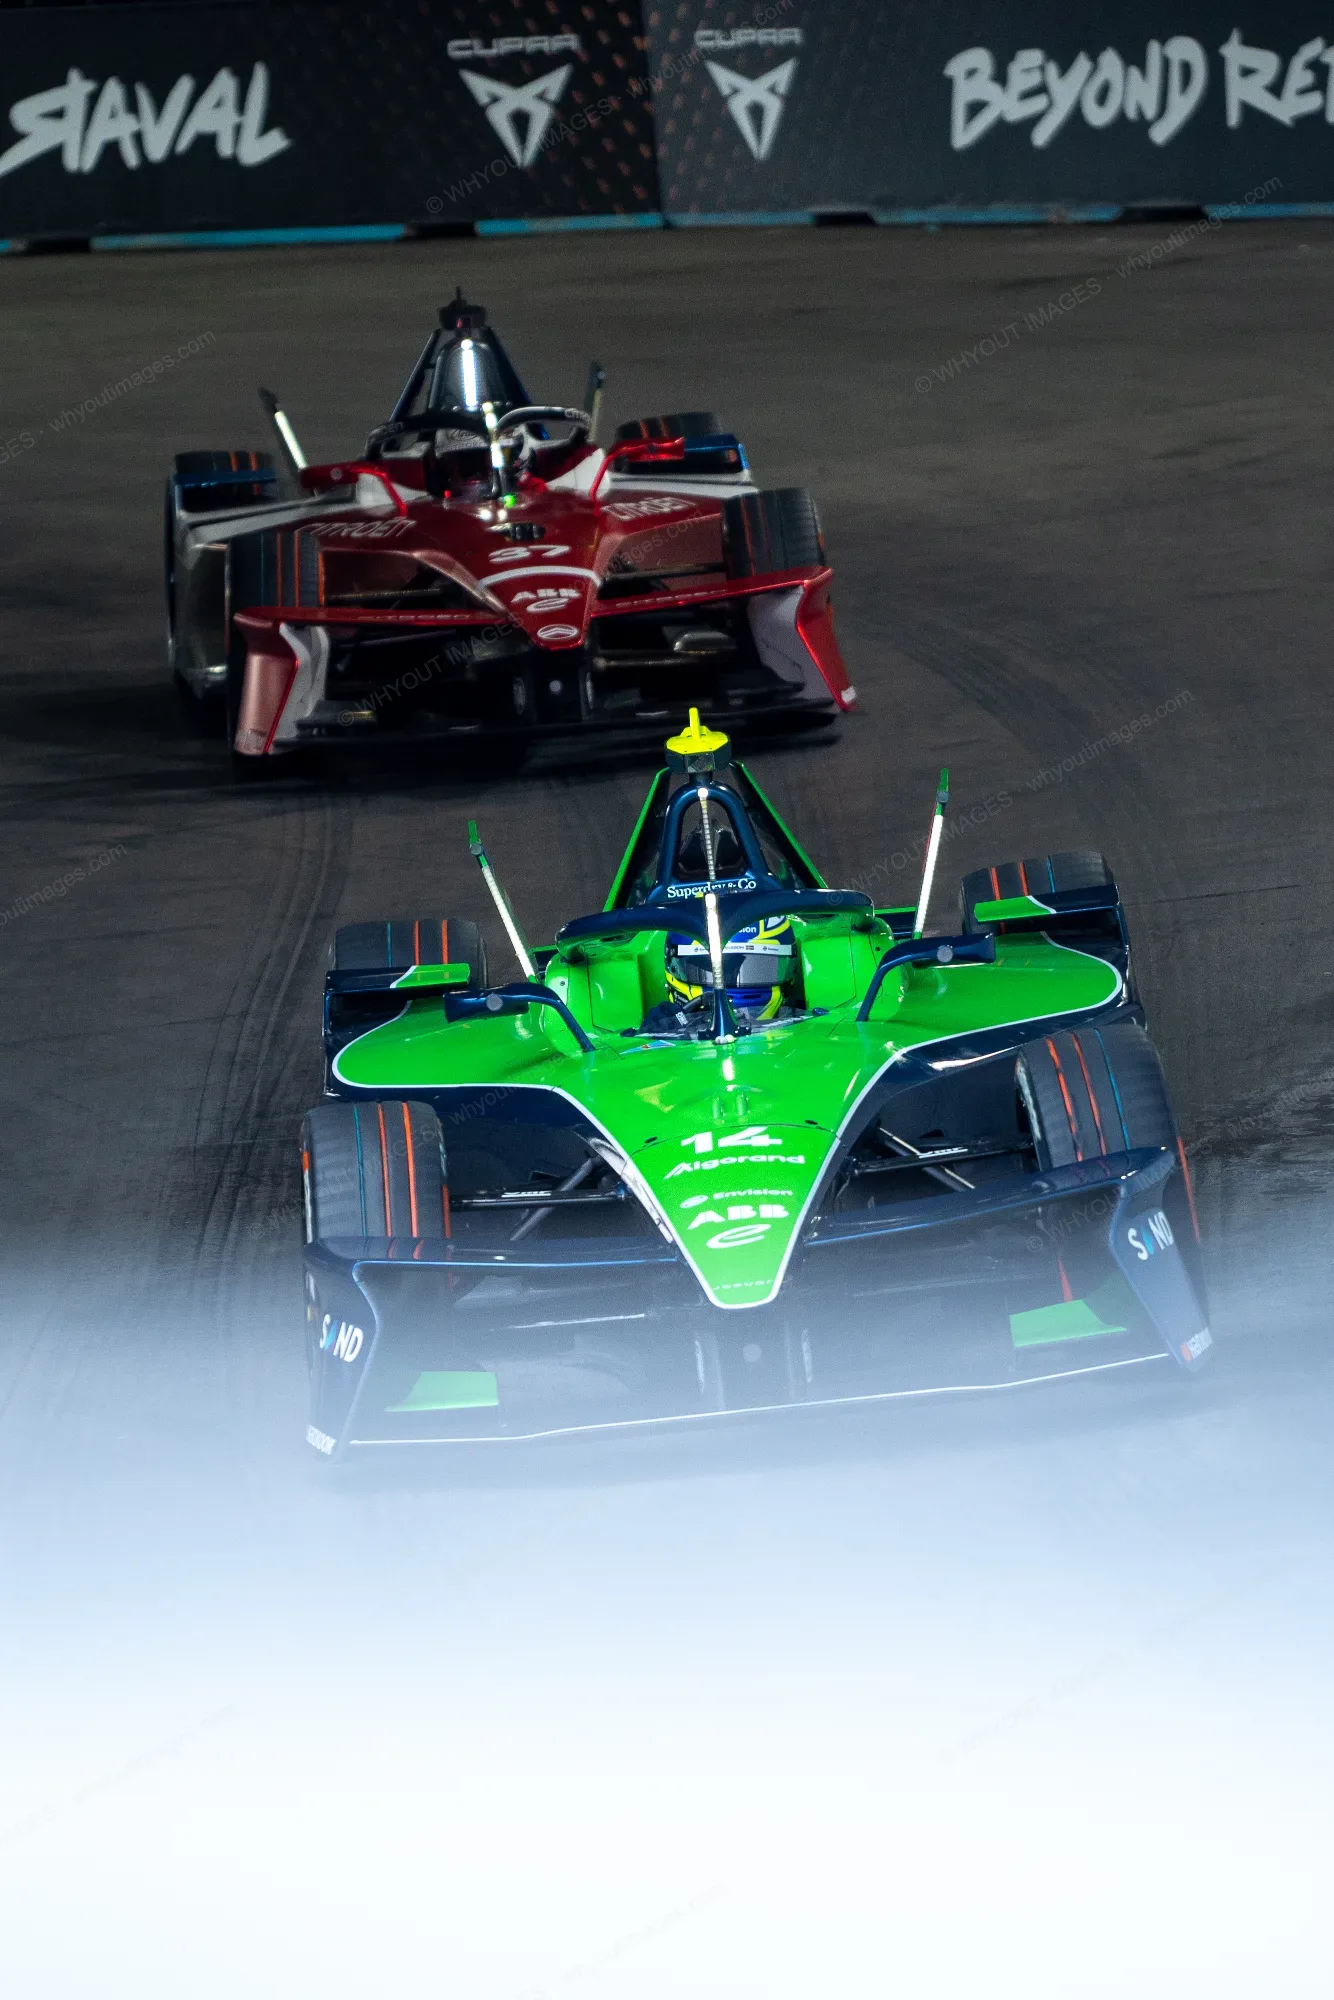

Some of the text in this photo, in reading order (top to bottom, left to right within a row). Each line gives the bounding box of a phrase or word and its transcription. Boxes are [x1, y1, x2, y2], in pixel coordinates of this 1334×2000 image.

[448, 33, 580, 59] CUPRA
[693, 27, 803, 48] CUPRA
[945, 36, 1206, 149] BEYOND
[488, 544, 571, 564] 37
[510, 588, 582, 603] ABB
[680, 1126, 783, 1155] 14
[663, 1155, 806, 1180] Algorand
[687, 1204, 790, 1230] ABB
